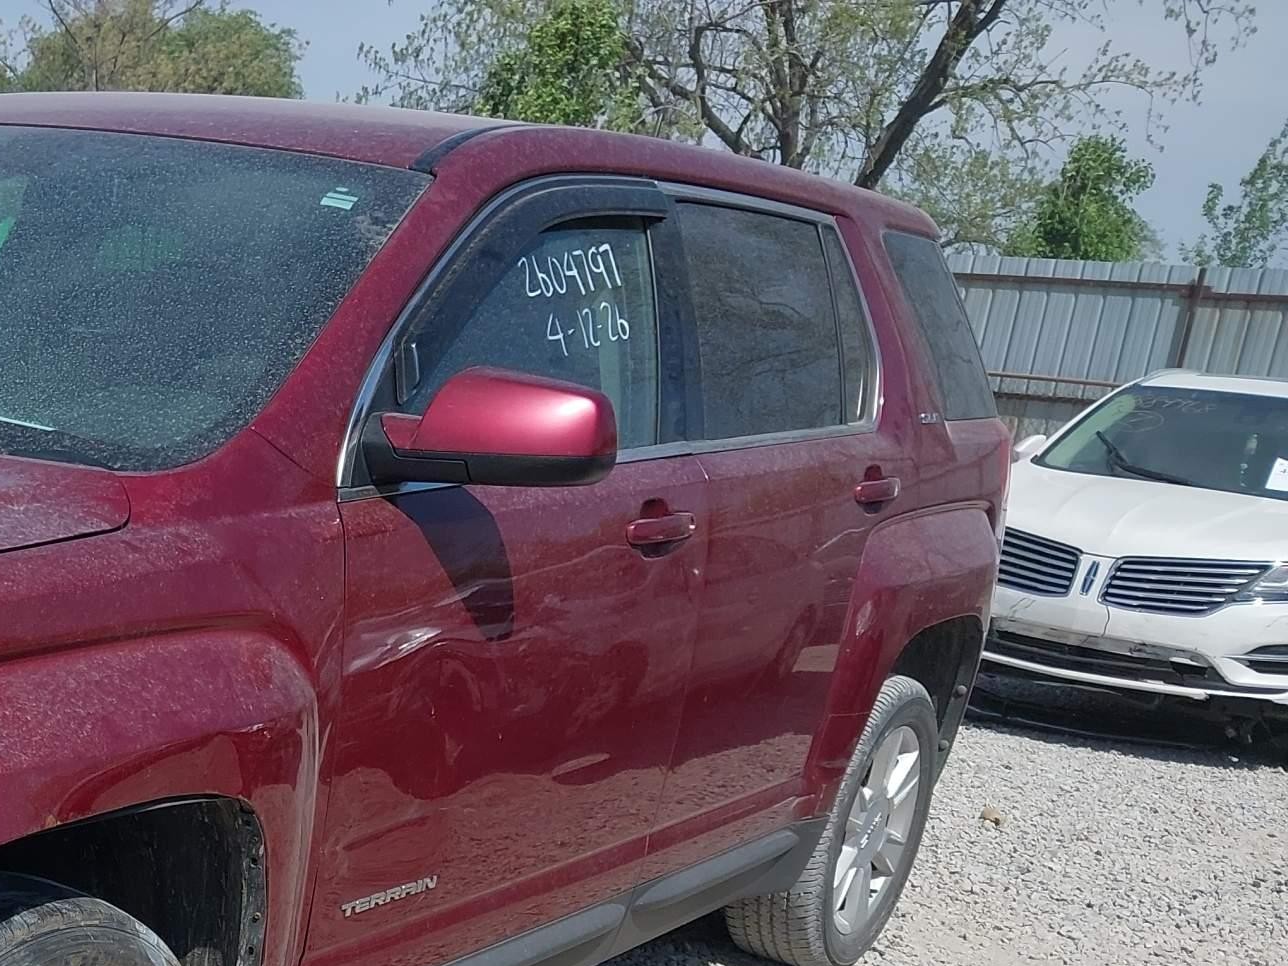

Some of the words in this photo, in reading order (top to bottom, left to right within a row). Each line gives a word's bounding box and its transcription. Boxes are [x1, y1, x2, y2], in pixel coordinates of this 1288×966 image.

[517, 243, 622, 297] 2604797
[546, 302, 630, 356] 4-12-26
[341, 875, 438, 918] TERRAIN
